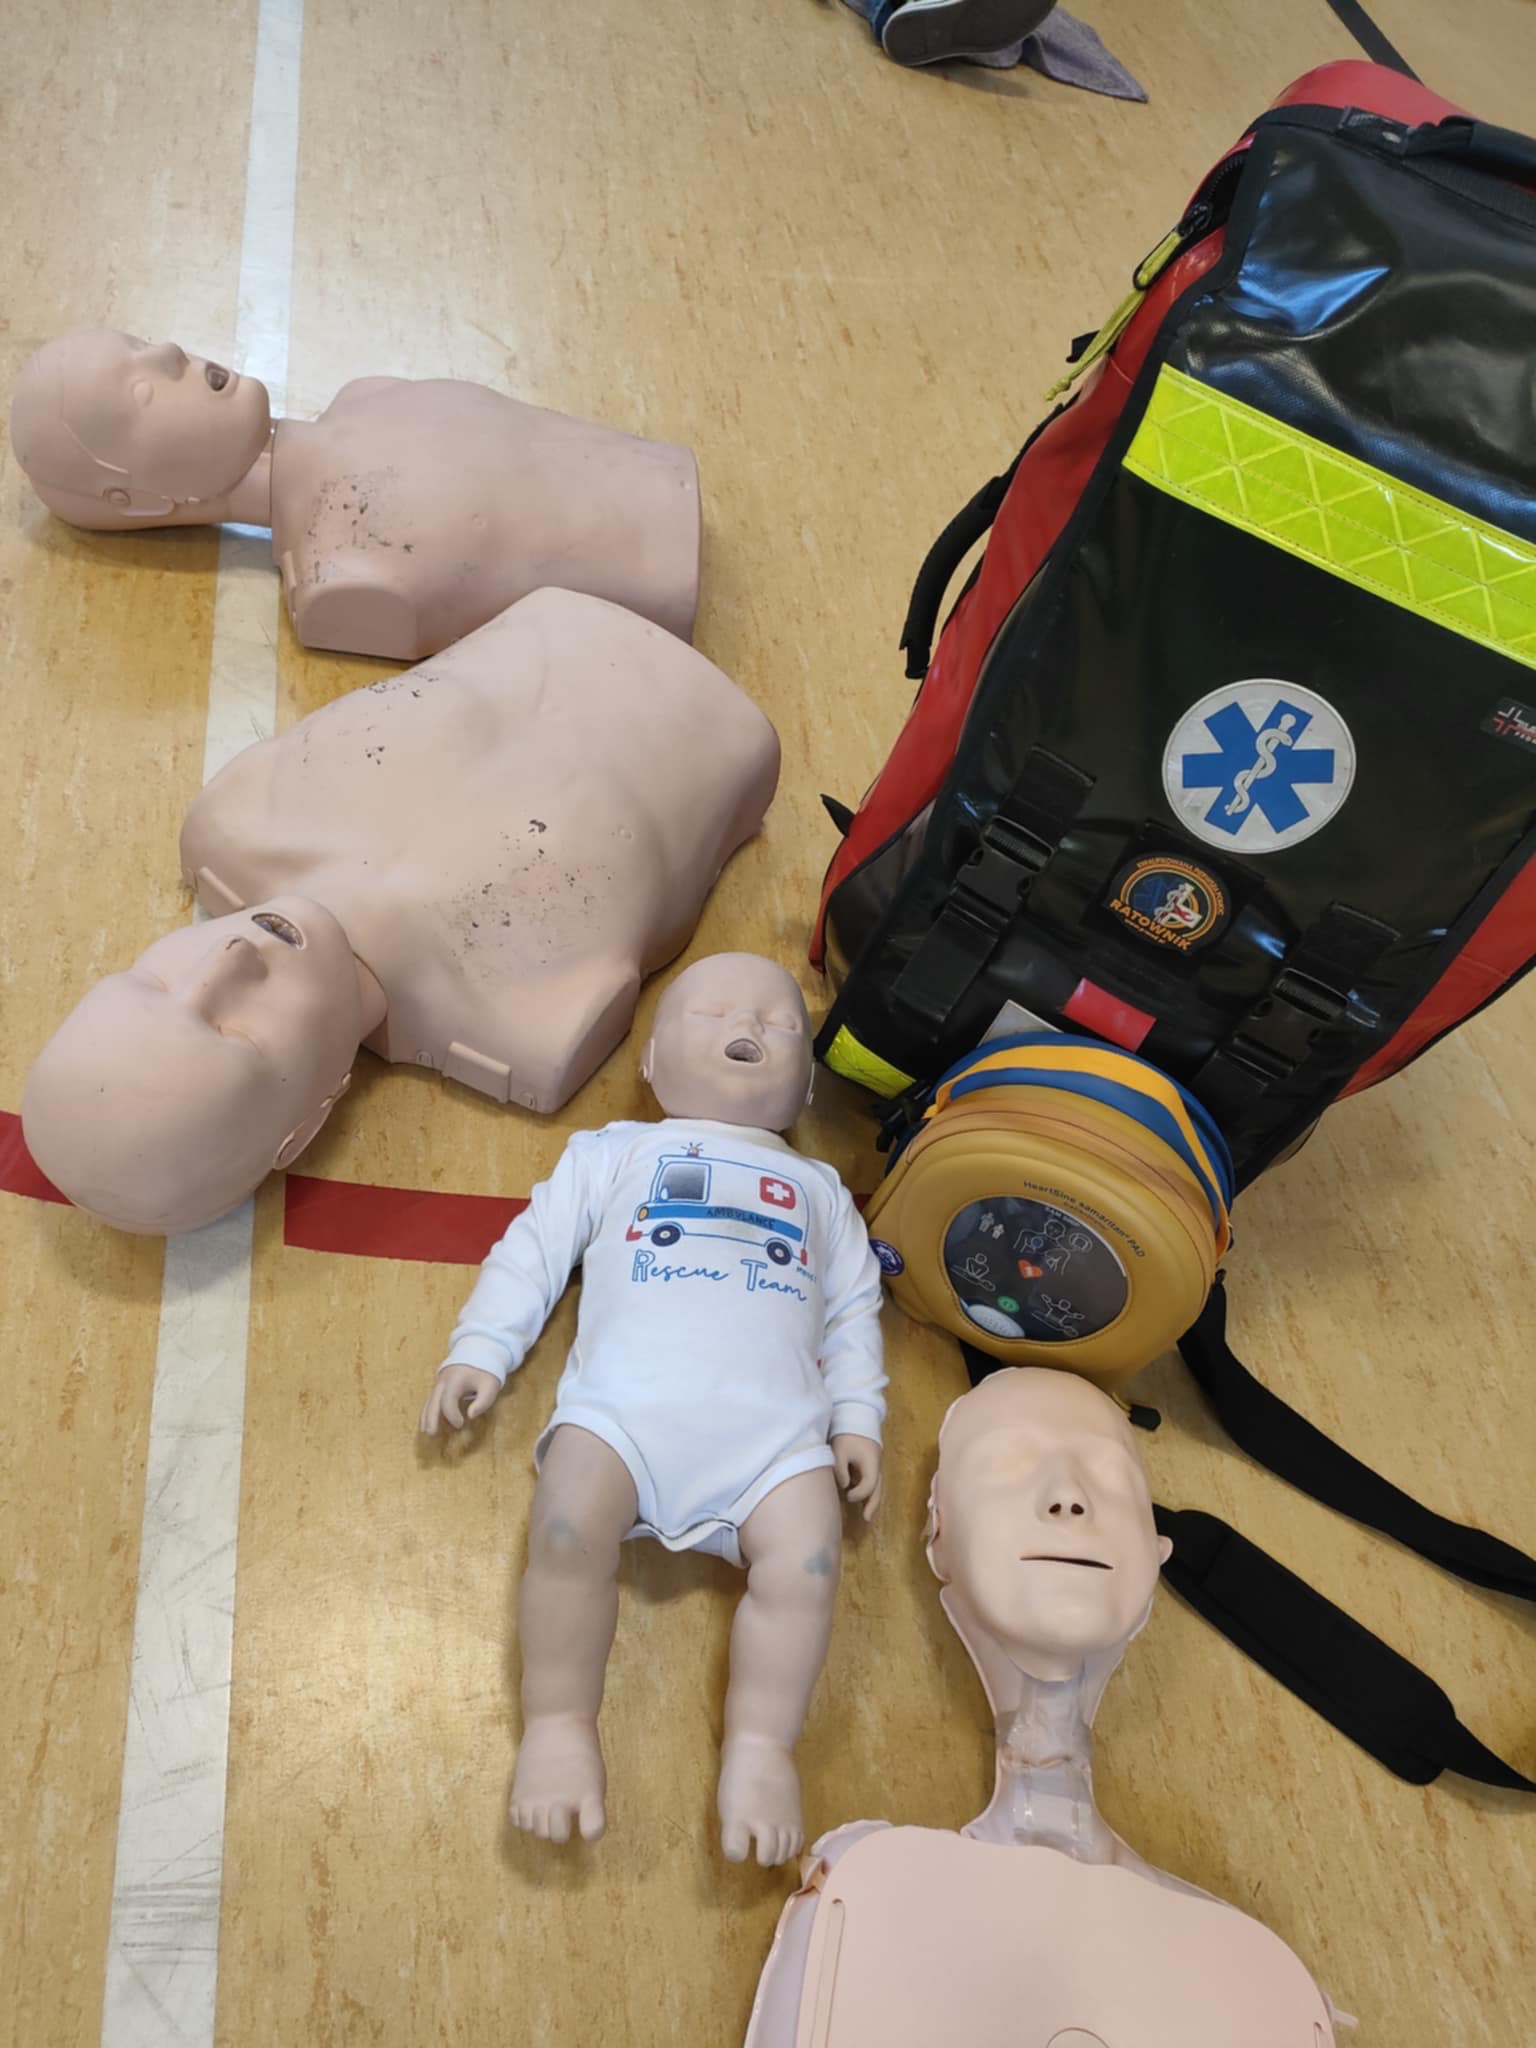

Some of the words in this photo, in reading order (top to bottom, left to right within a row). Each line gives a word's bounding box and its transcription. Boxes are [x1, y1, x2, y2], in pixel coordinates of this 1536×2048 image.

[1109, 898, 1191, 951] RATOWNIK
[706, 1206, 776, 1231] AMBULANCE
[1023, 1180, 1076, 1203] HeartSine
[1127, 1238, 1146, 1259] PAD
[632, 1249, 729, 1282] Rescue
[740, 1258, 807, 1301] Team
